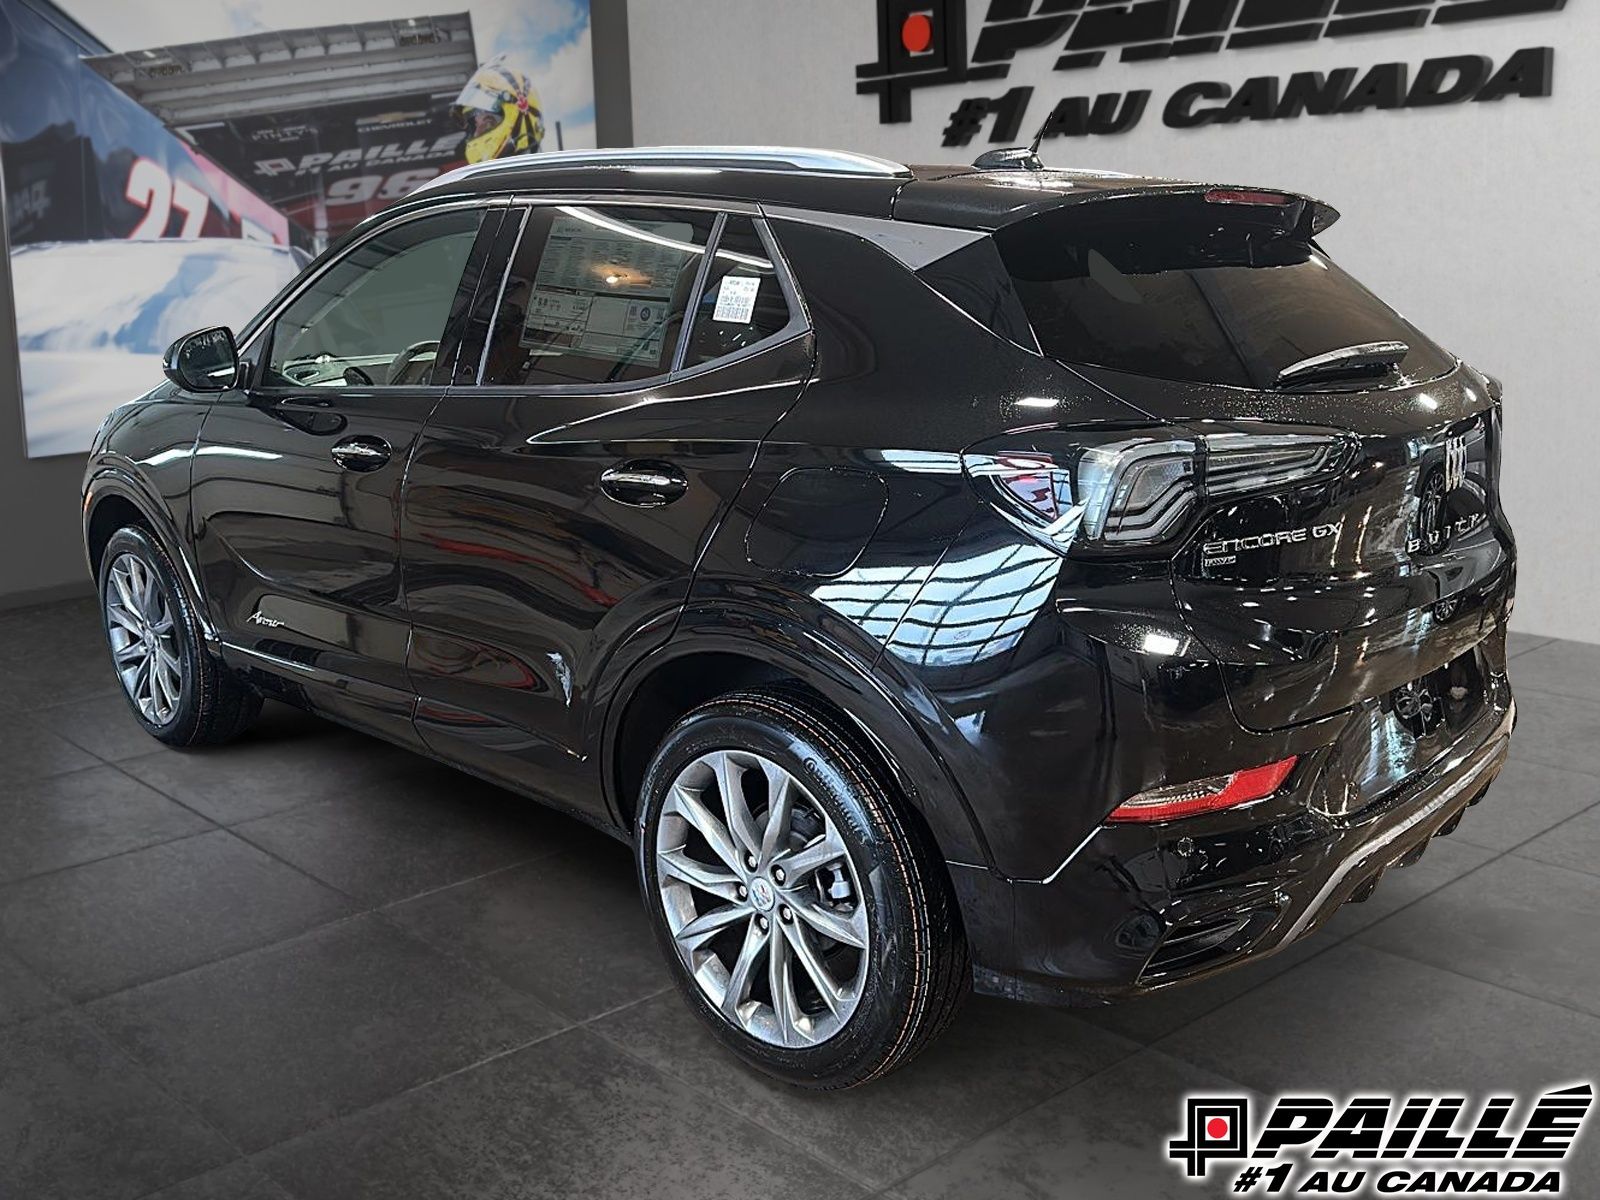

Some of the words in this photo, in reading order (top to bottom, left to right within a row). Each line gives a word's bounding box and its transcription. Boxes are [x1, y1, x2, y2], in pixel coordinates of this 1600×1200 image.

[1034, 90, 1152, 139] AU
[1162, 46, 1554, 129] CANADA
[1312, 521, 1342, 538] GX
